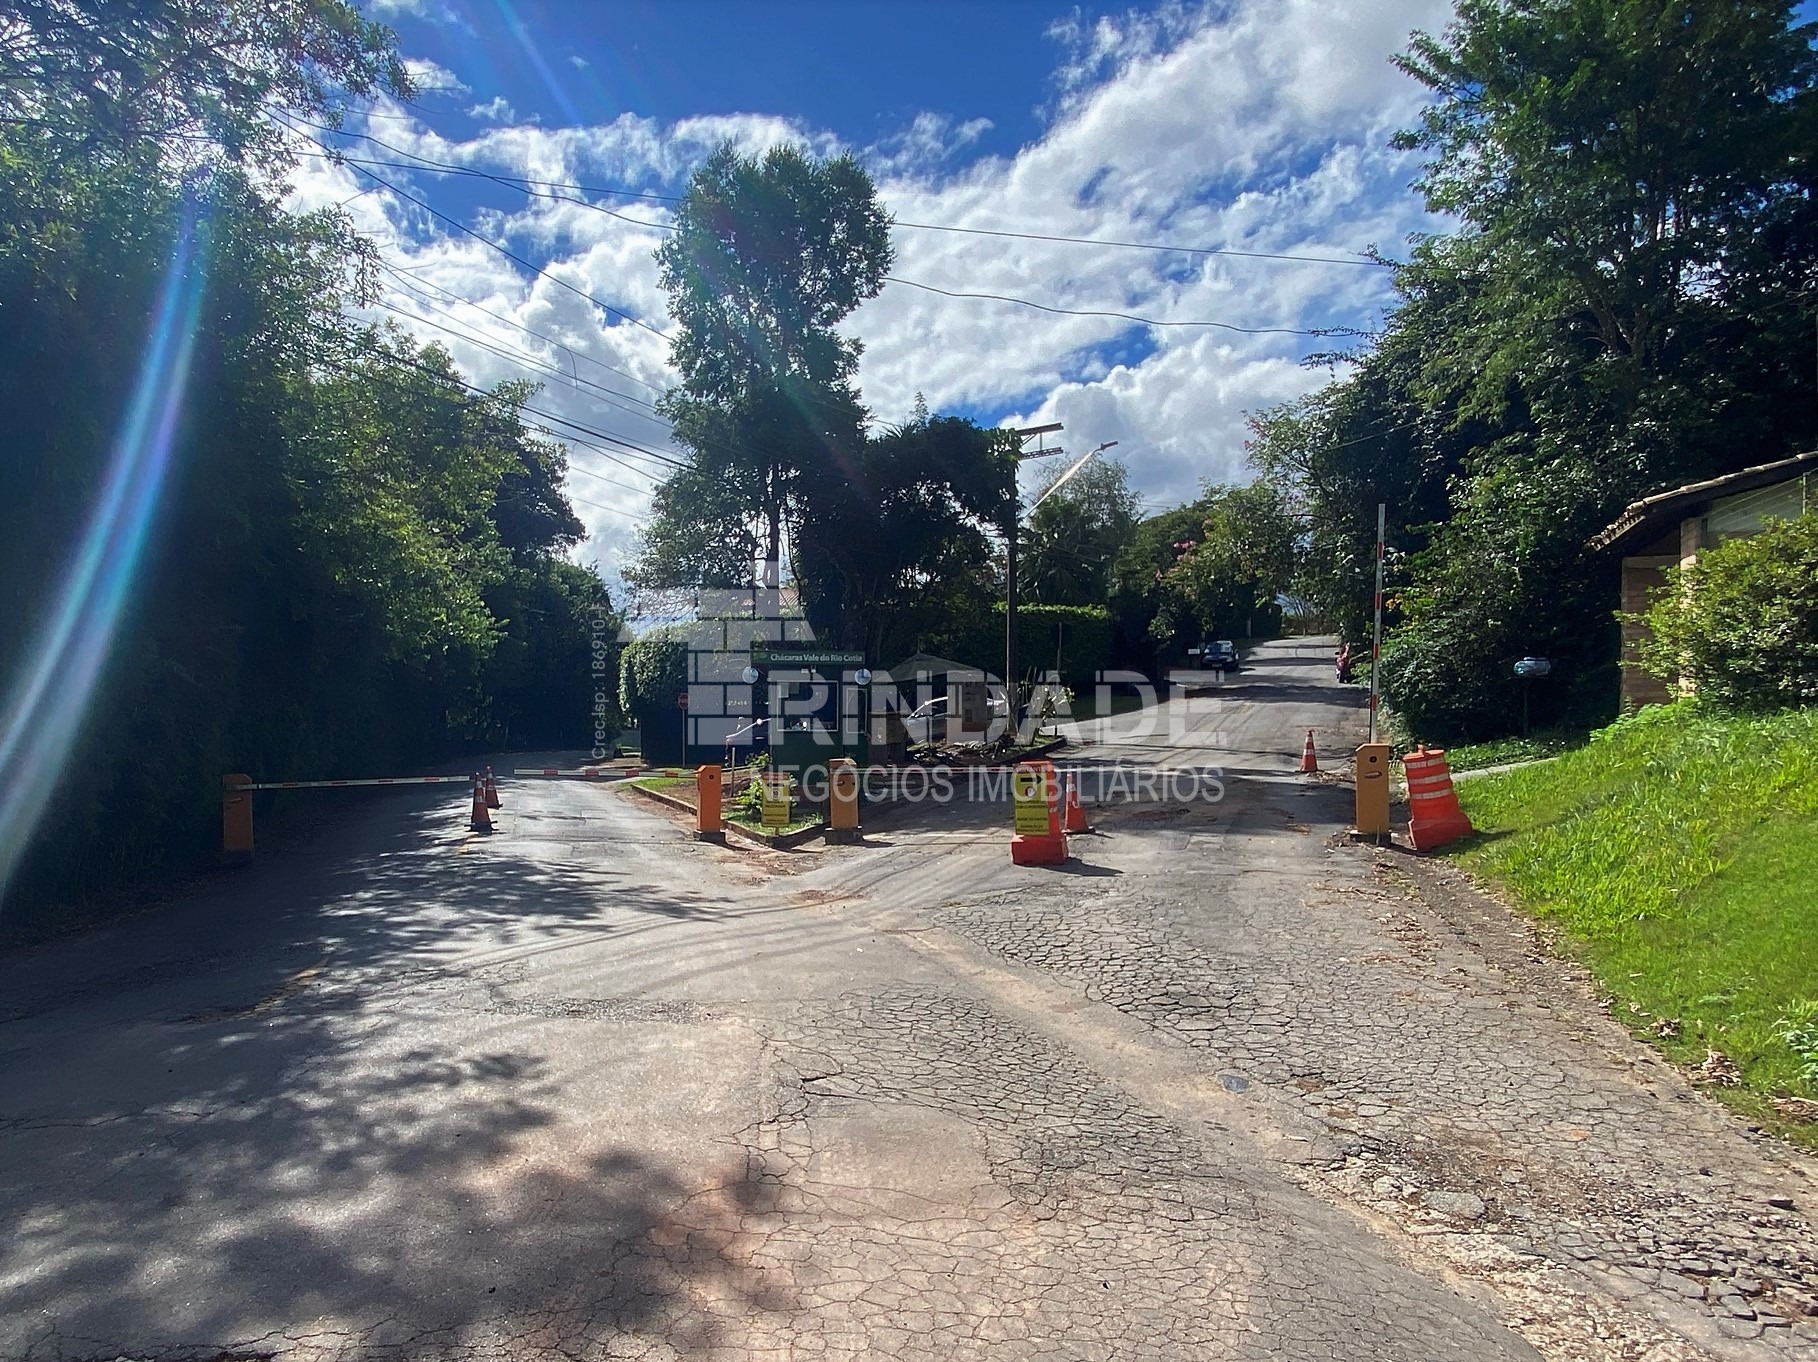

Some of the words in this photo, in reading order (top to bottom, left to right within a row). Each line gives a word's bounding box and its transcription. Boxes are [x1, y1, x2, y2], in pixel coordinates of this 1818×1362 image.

[770, 653, 803, 661] Chácaras
[803, 653, 819, 662] Vale
[820, 653, 829, 662] do
[831, 653, 842, 662] Rio
